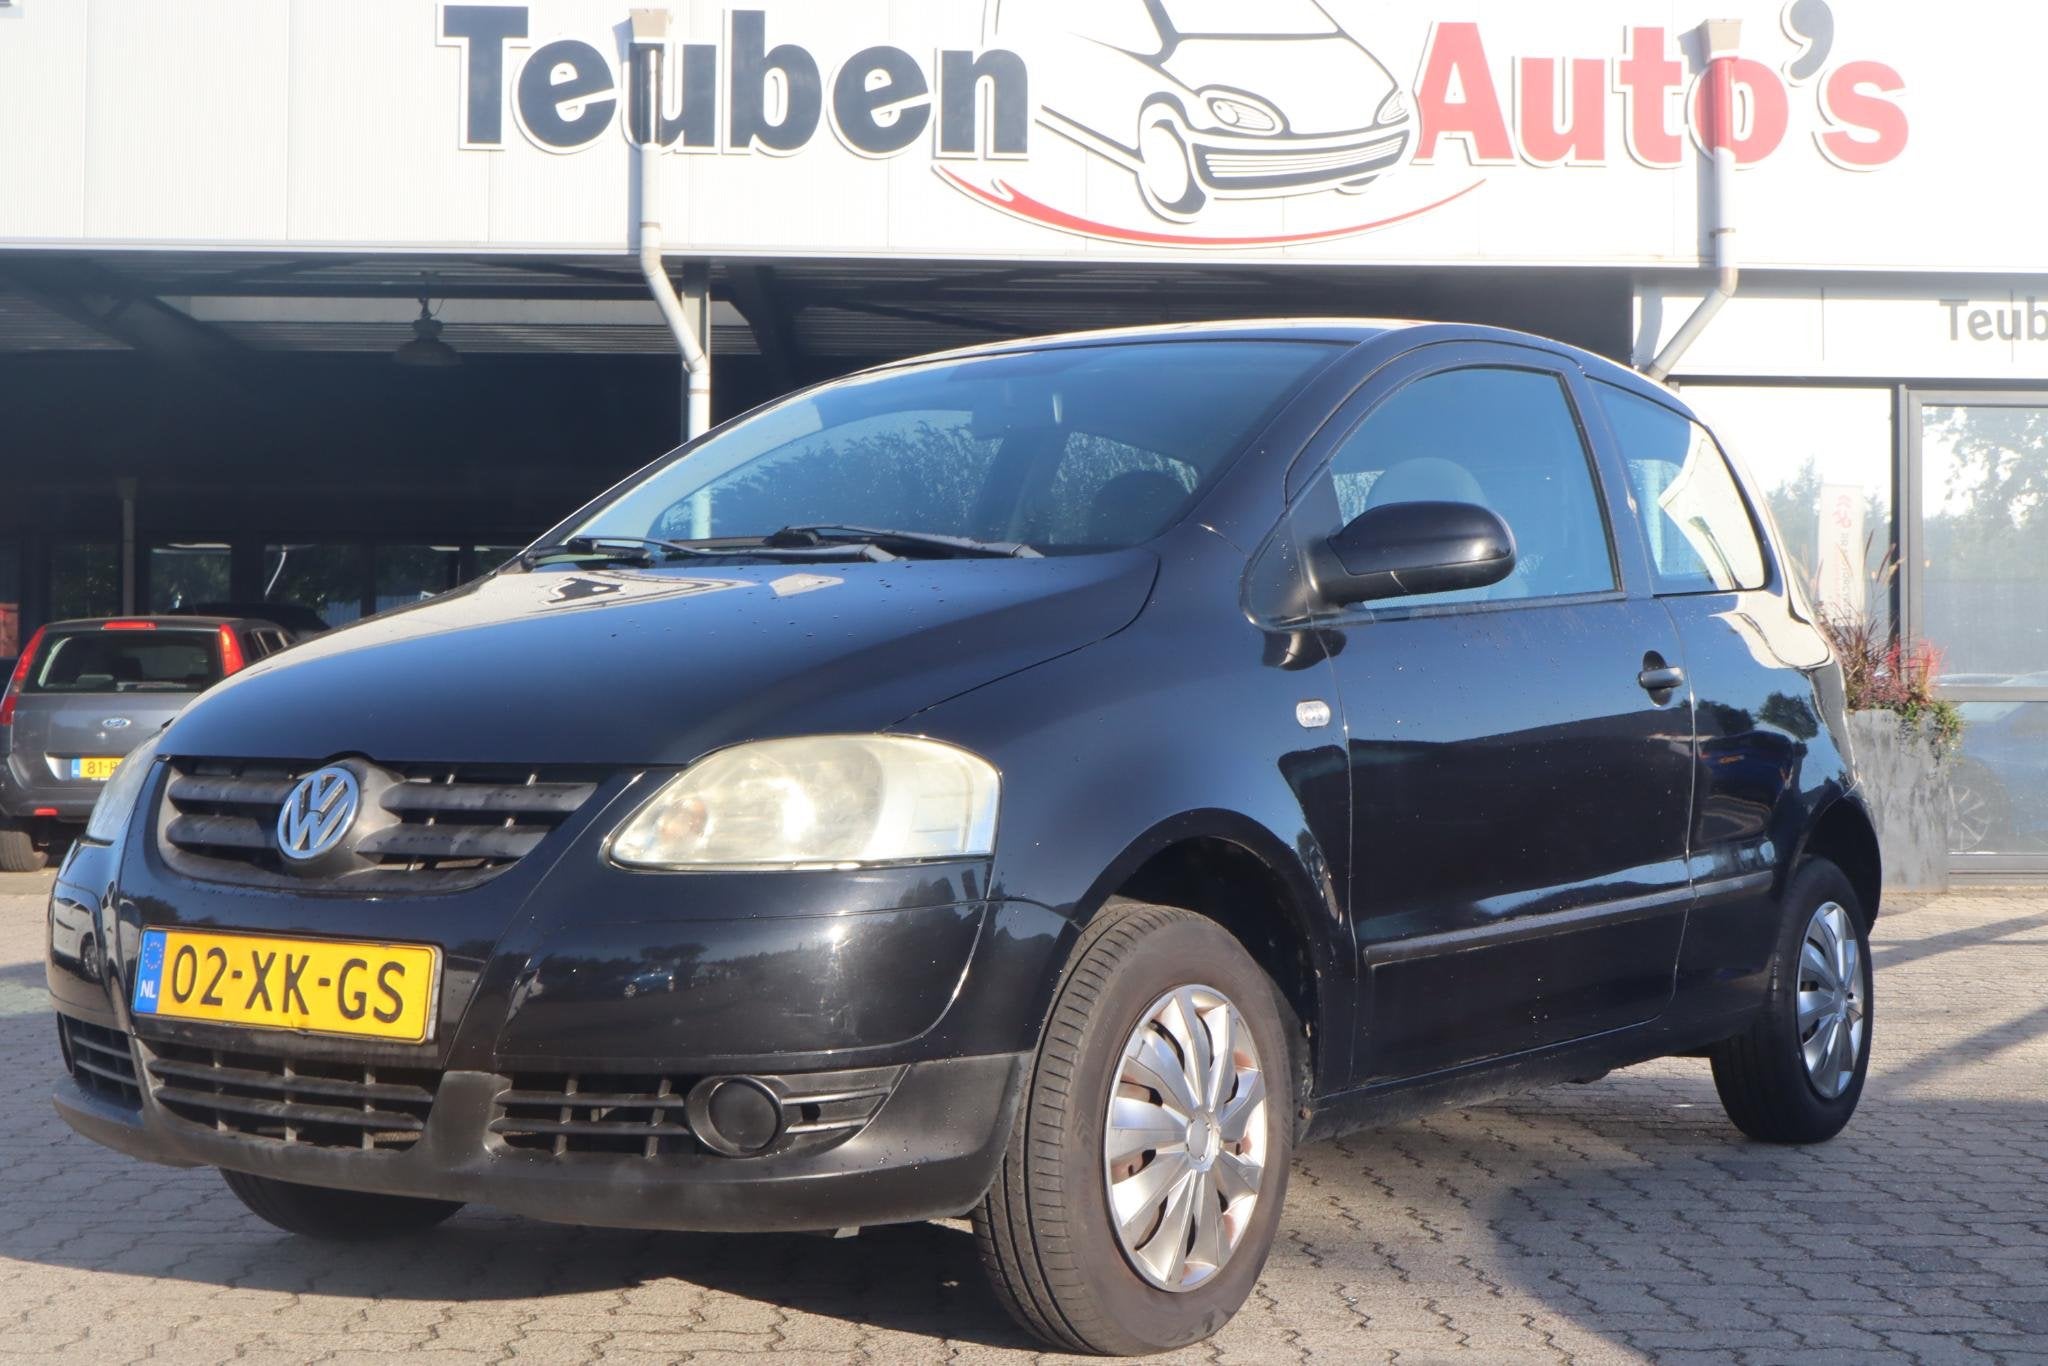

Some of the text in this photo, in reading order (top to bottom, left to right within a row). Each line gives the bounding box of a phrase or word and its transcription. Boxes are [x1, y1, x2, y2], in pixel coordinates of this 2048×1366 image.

[443, 0, 1909, 166] Teuben Auto's
[139, 978, 156, 999] NL
[171, 944, 405, 1024] 02-XK-GS
